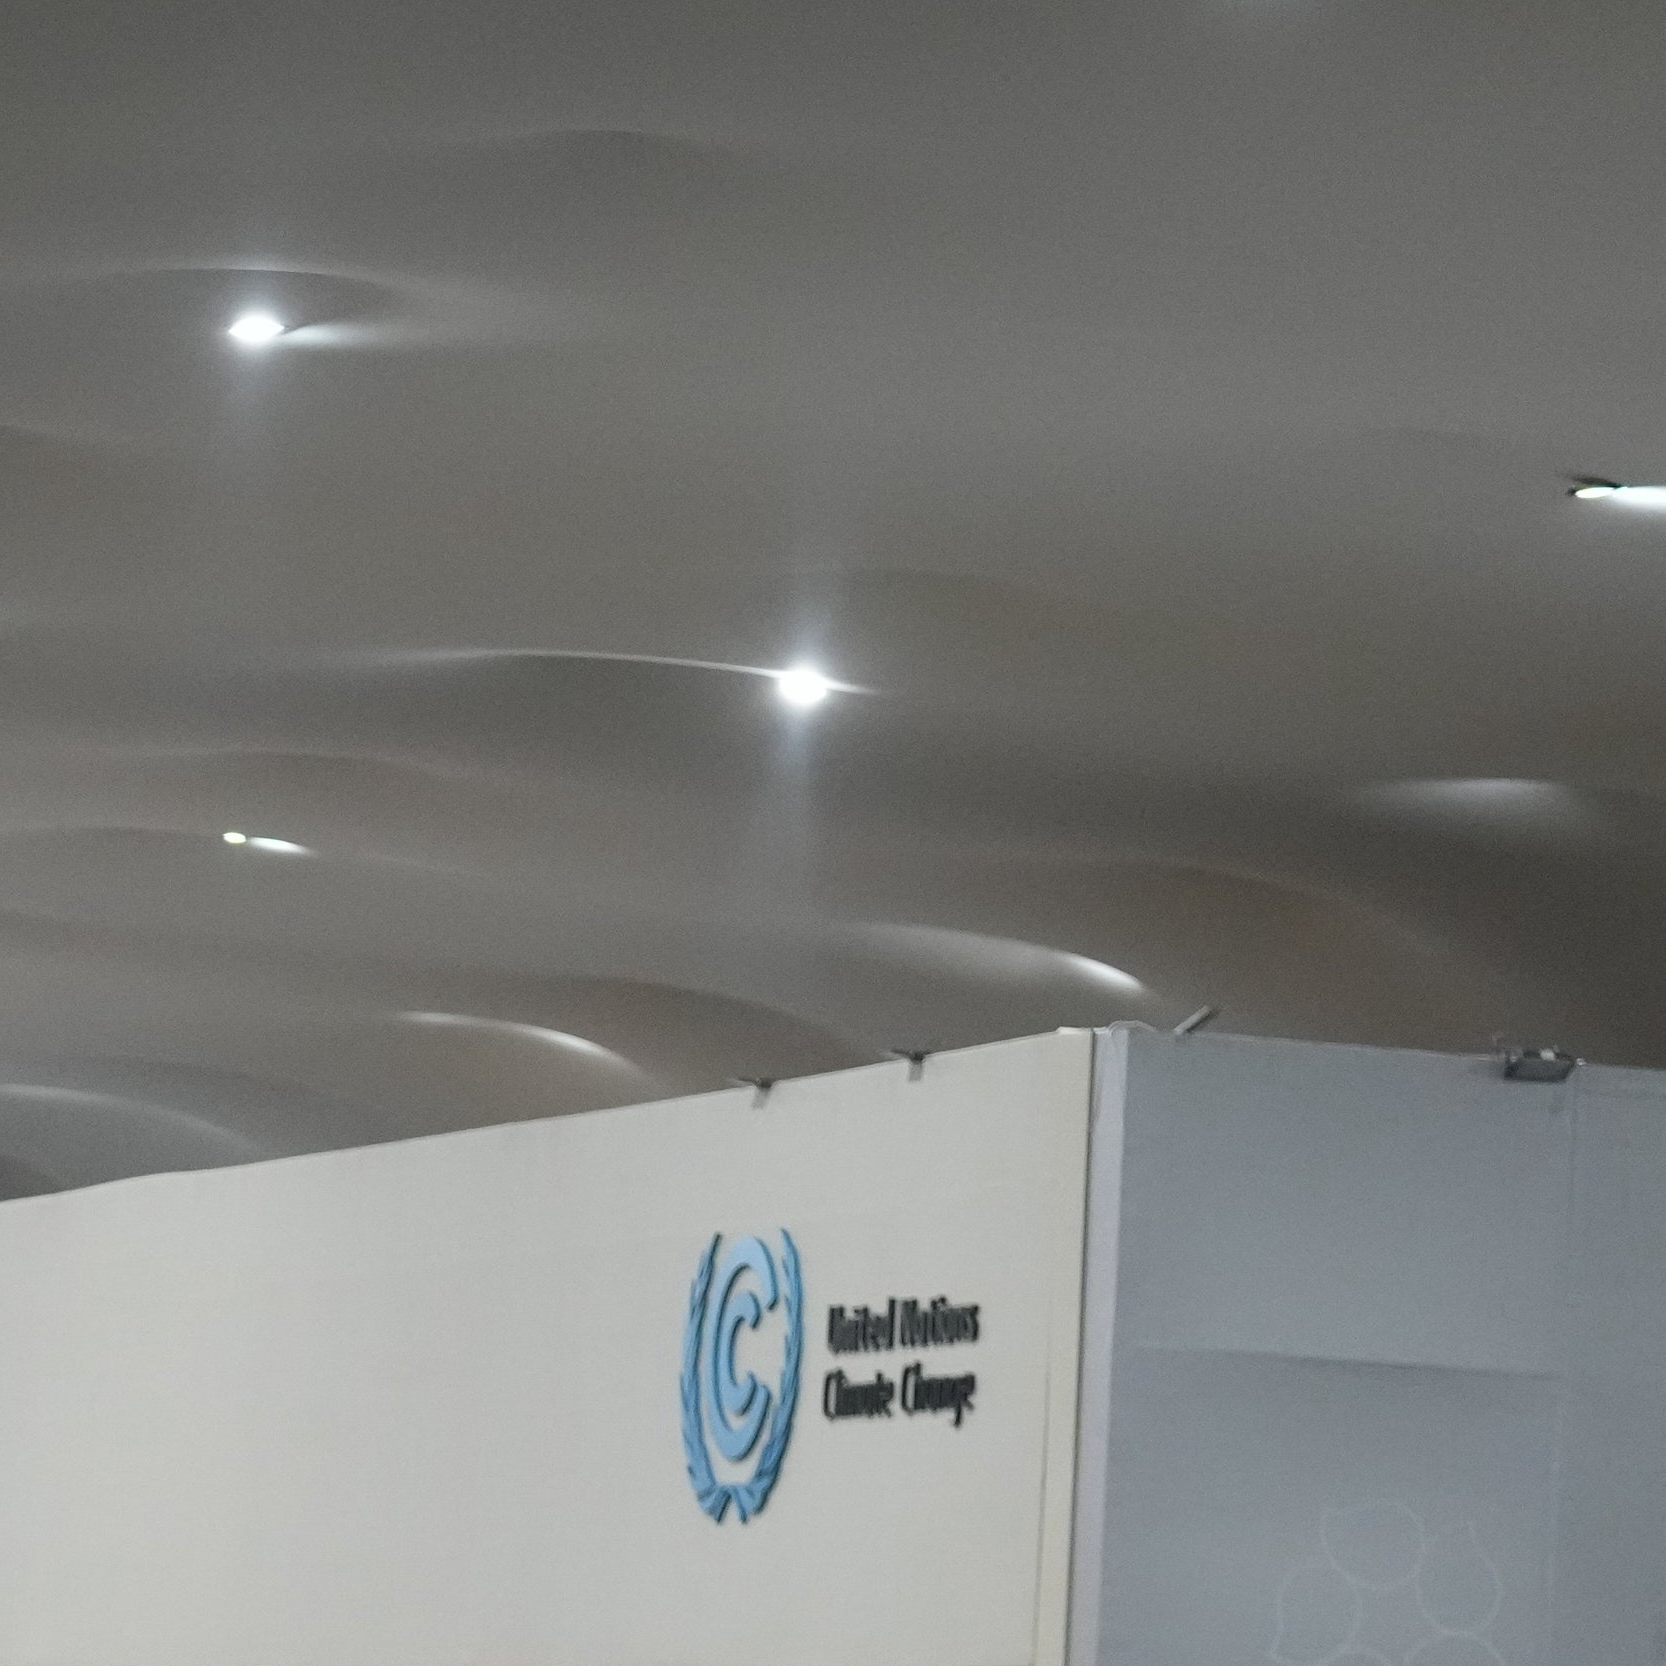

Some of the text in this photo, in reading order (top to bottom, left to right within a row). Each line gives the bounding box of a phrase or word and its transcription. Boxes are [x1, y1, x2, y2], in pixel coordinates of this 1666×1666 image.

[828, 1296, 980, 1355] United Nations
[823, 1361, 976, 1427] Climate Change
